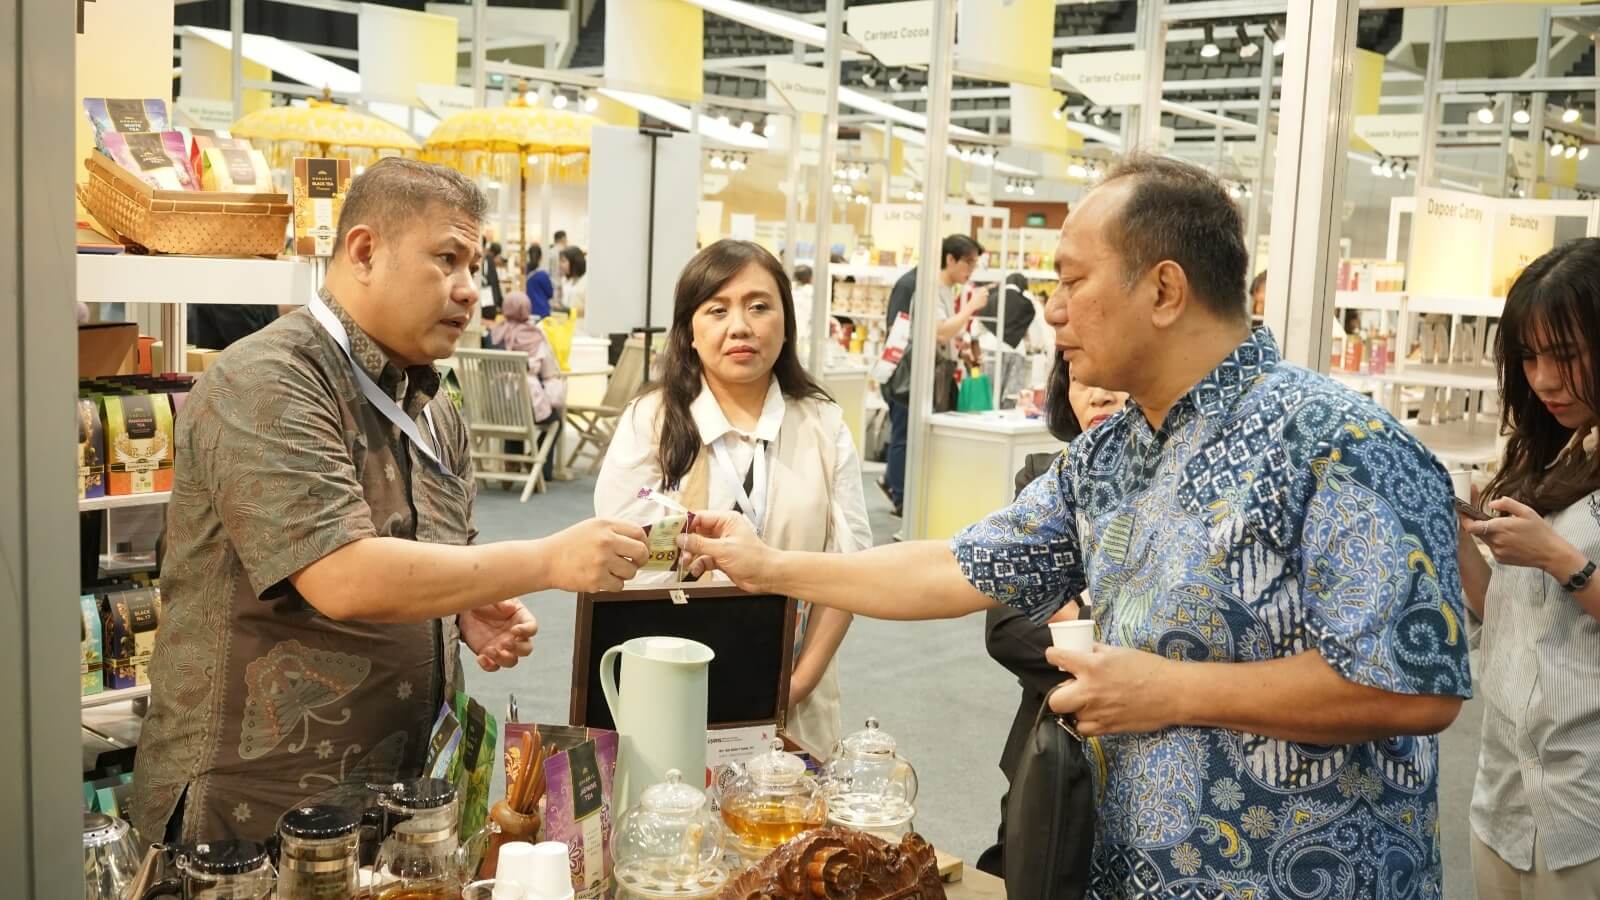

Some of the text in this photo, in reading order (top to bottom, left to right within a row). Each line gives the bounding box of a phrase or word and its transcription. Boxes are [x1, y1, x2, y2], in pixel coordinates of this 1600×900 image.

[864, 27, 929, 41] Cartenz Cocoa
[1113, 72, 1141, 81] Cocoa
[584, 792, 594, 801] TEA
